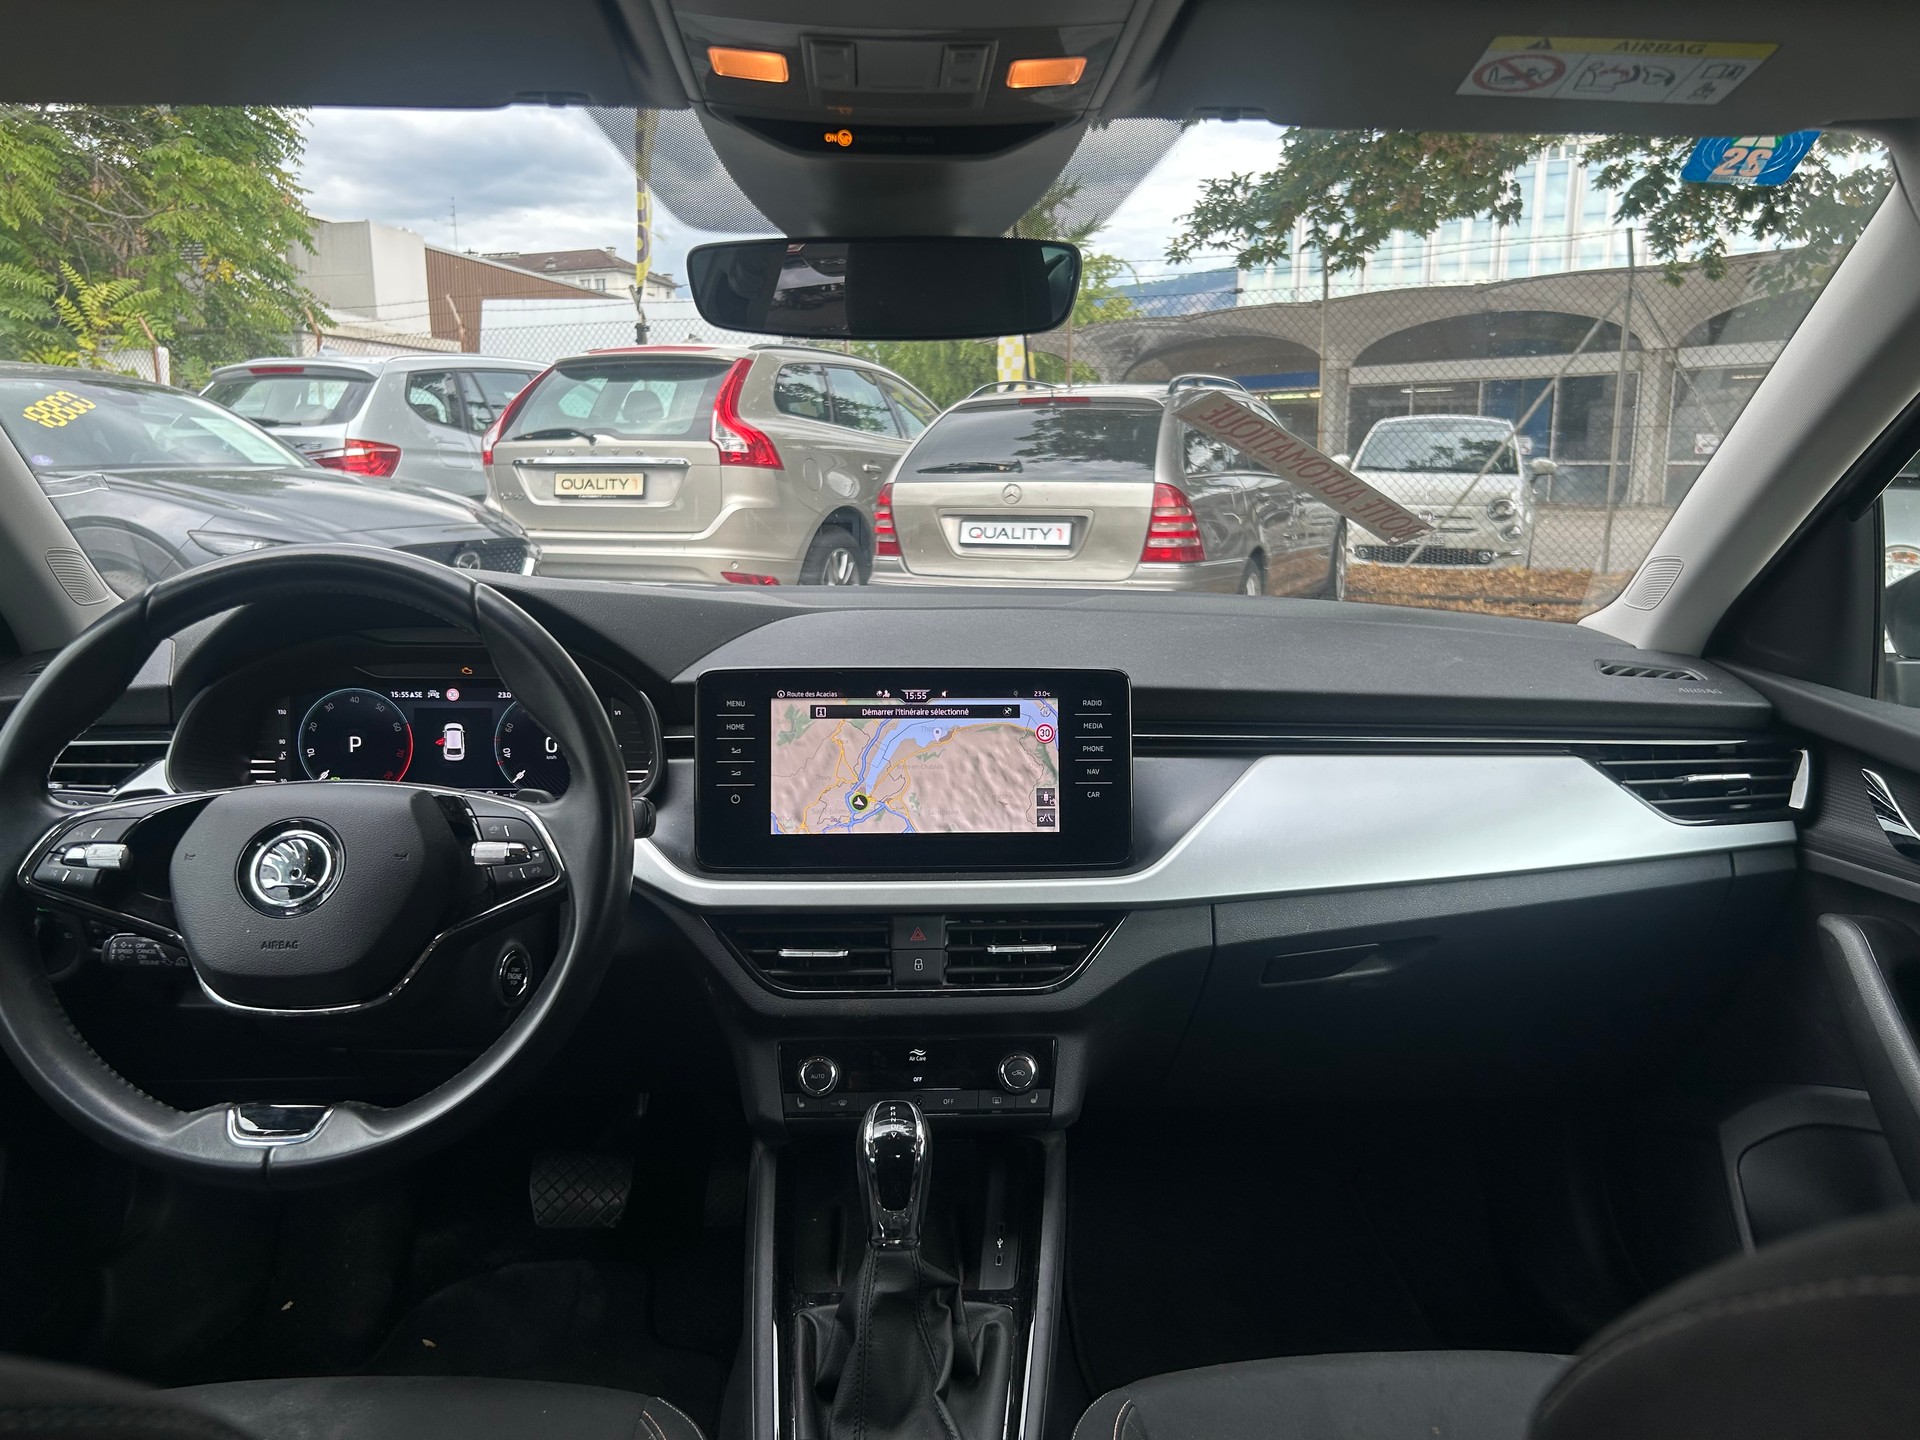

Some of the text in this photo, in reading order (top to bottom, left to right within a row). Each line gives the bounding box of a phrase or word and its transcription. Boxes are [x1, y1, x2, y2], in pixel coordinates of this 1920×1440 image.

[1615, 40, 1706, 55] AIRBAG
[825, 133, 838, 143] ON
[546, 447, 645, 457] VOLVO
[560, 478, 628, 491] QUALITY
[968, 526, 1052, 541] QUALITY
[905, 692, 927, 700] 15:55
[324, 702, 335, 713] 30
[375, 703, 386, 713] 50
[861, 708, 894, 716] Démarrer
[930, 707, 970, 716] sélectionné
[309, 721, 318, 732] 20
[504, 723, 514, 733] 60
[1040, 728, 1051, 738] 30
[349, 736, 362, 753] P
[306, 748, 316, 758] 10
[503, 747, 512, 758] 40
[261, 940, 299, 950] AIRBAG
